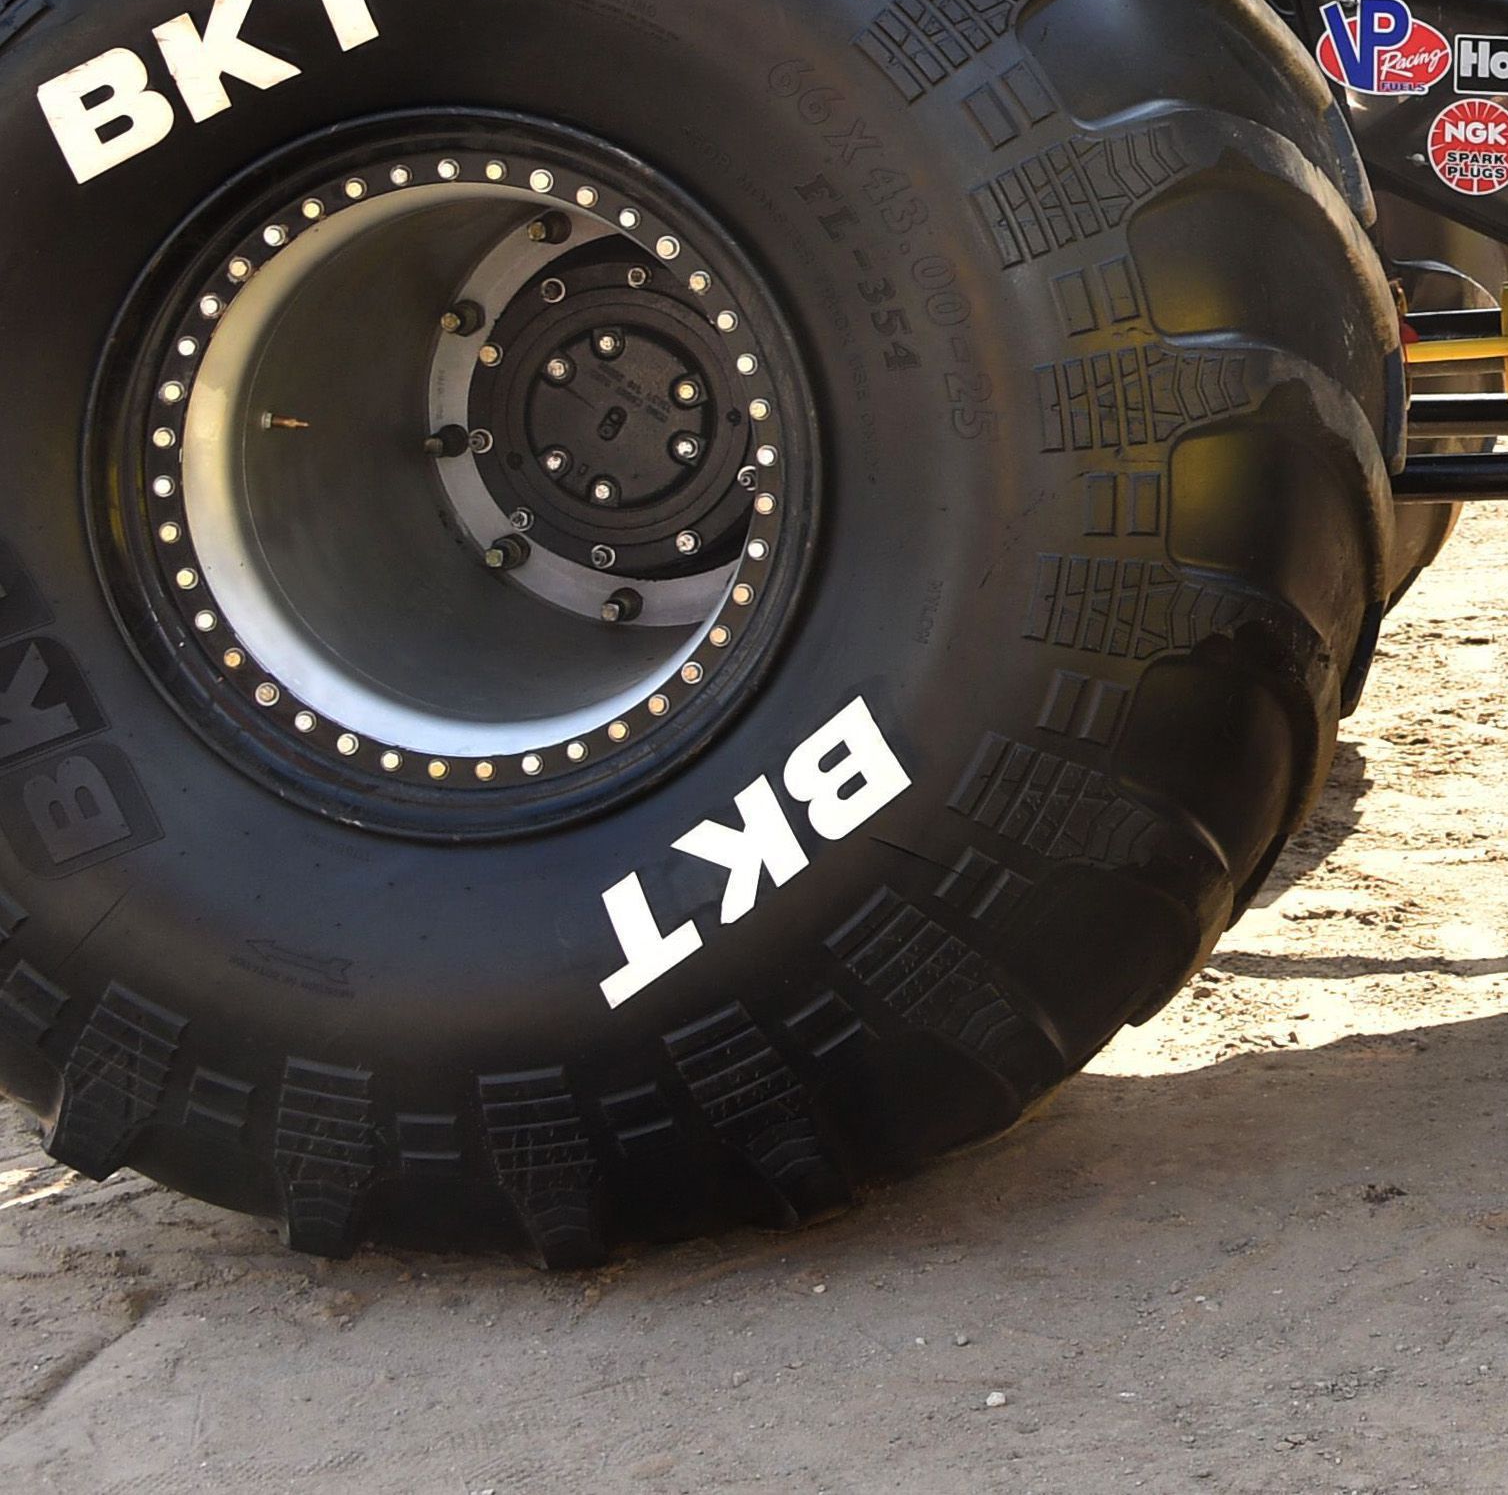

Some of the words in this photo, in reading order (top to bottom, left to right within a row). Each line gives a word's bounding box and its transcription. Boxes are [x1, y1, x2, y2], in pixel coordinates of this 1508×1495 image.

[1380, 48, 1450, 79] Racing
[1380, 81, 1426, 93] FUELS
[1444, 121, 1508, 145] NGK
[1446, 152, 1506, 165] SPARK
[1446, 166, 1506, 180] PLUGS
[600, 695, 913, 1009] BKT
